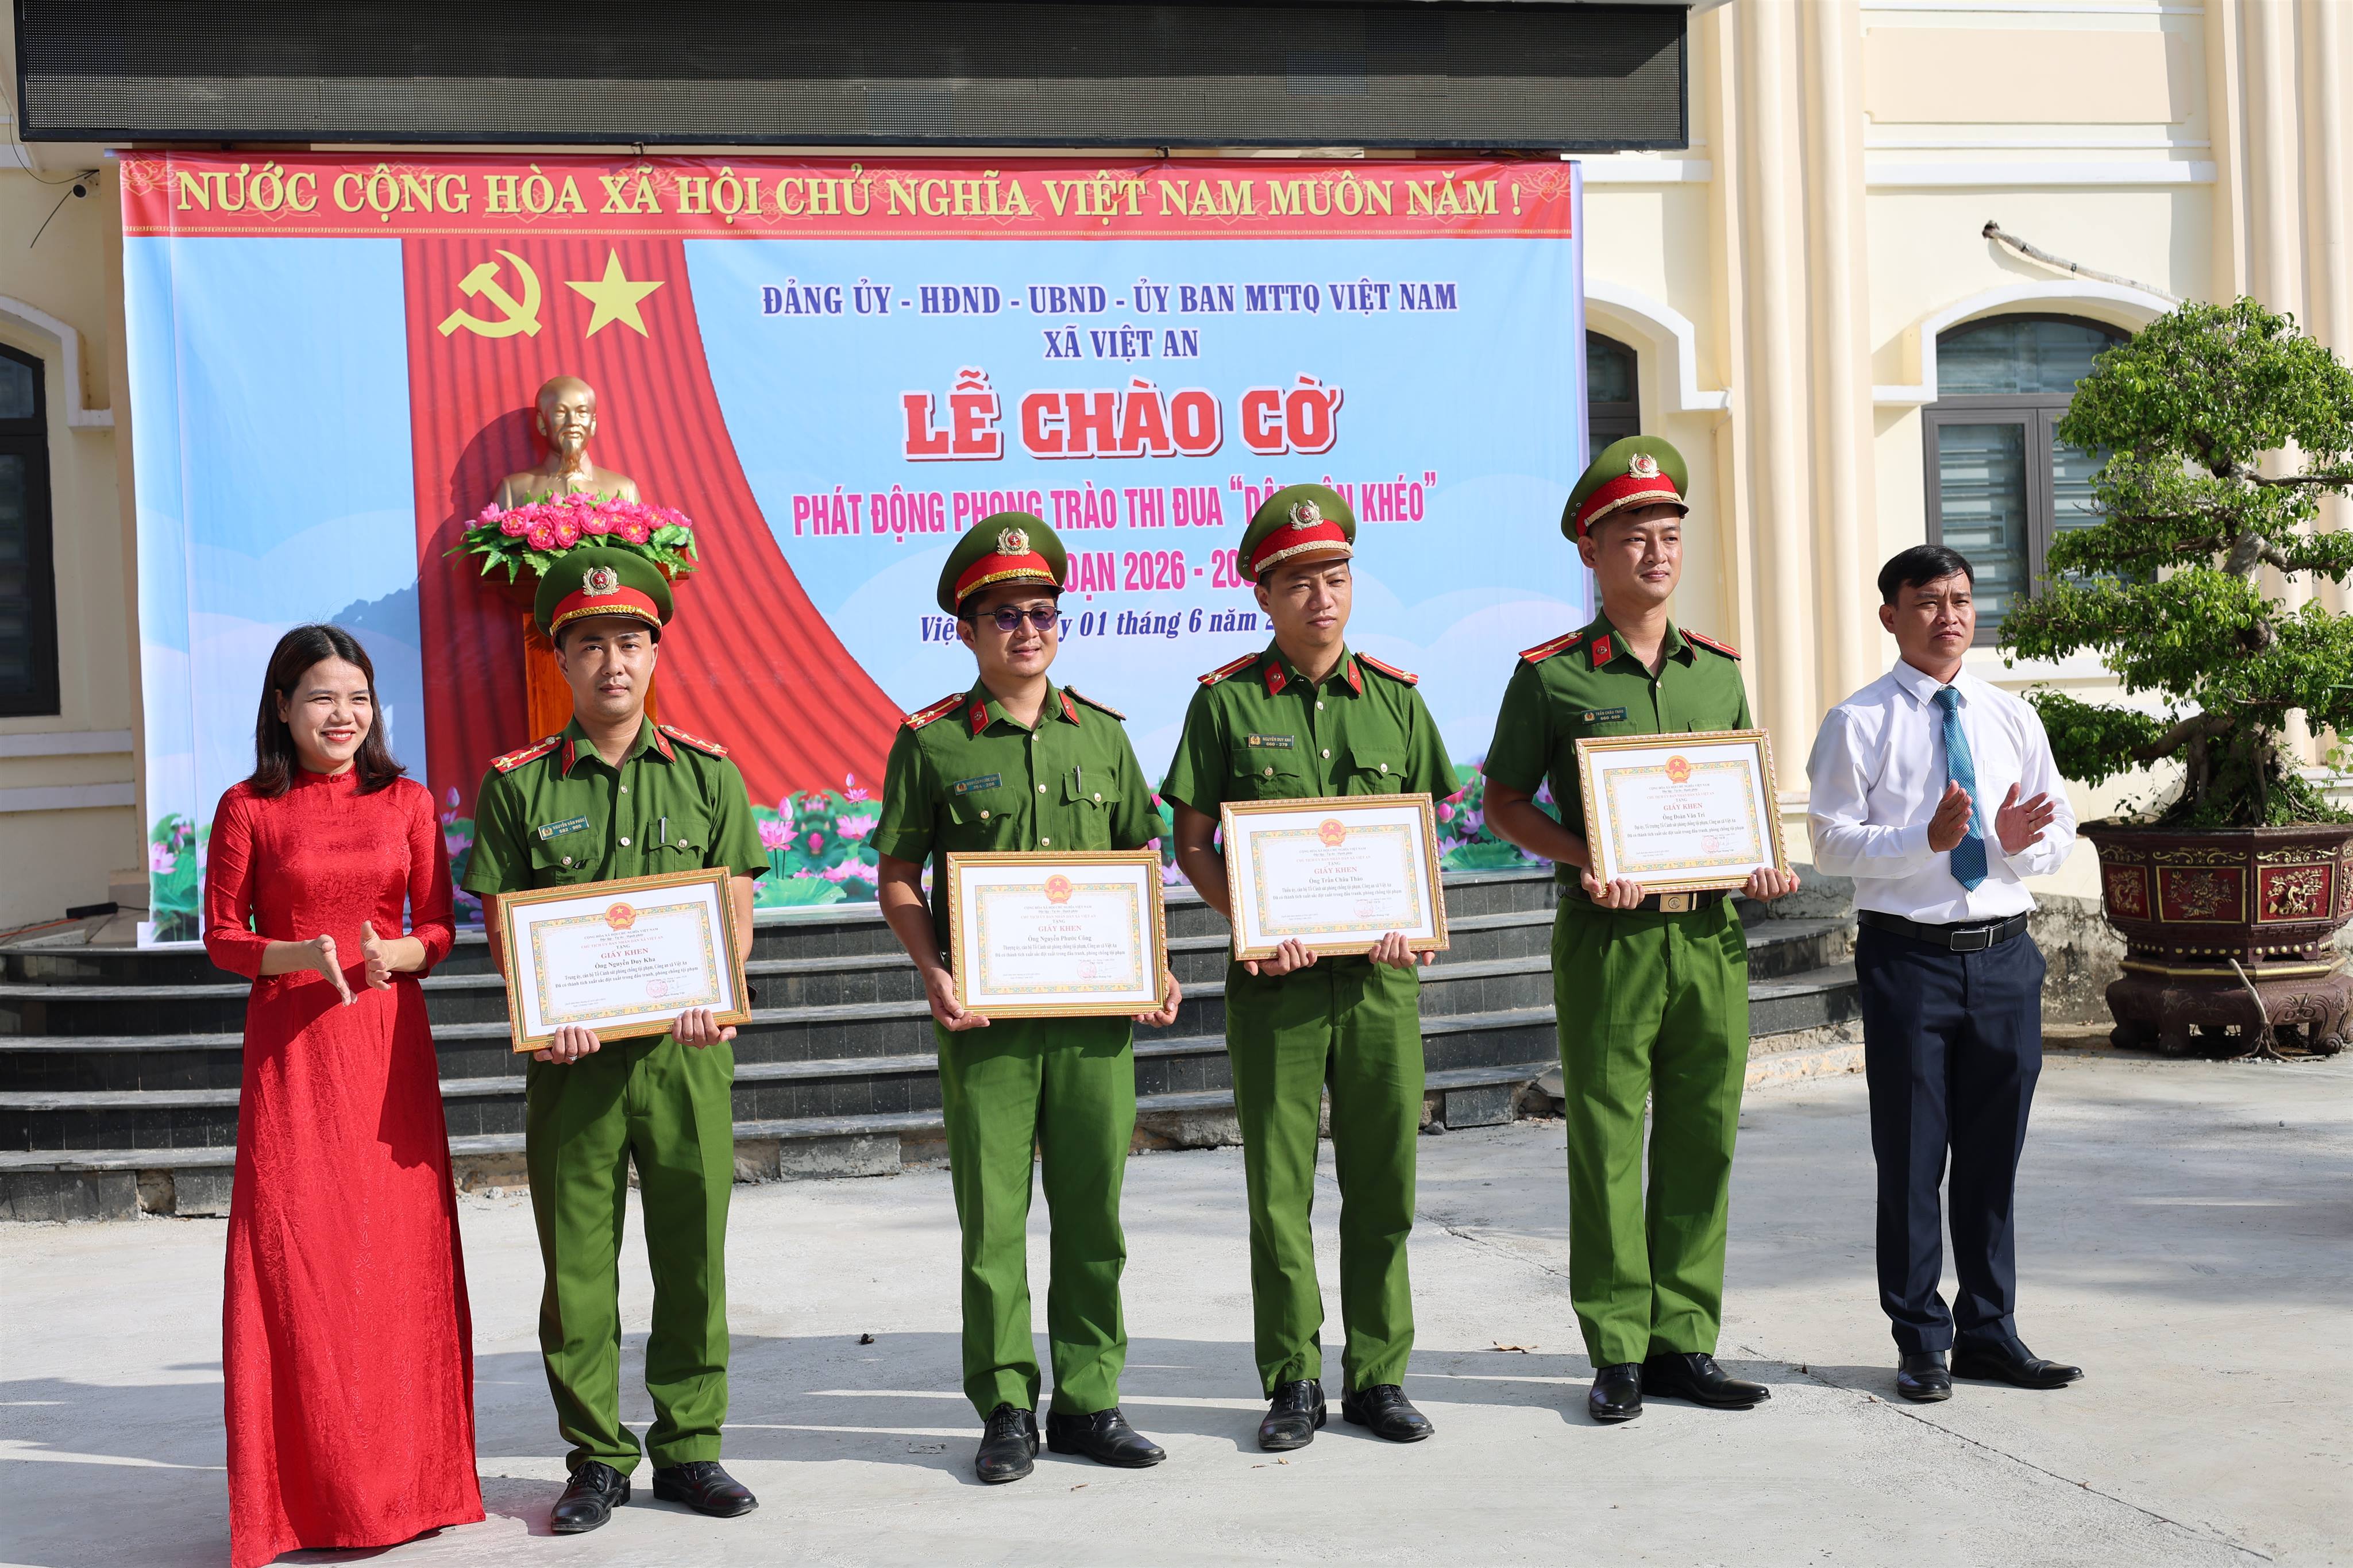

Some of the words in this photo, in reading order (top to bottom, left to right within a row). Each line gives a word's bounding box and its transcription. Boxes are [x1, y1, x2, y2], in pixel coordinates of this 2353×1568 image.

[177, 164, 319, 212] NƯỚC
[333, 164, 470, 221] CỘNG
[485, 164, 587, 214] HÒA
[599, 167, 662, 214] XÃ
[677, 168, 762, 223] HỘI
[776, 163, 871, 215] CHỦ
[886, 171, 1032, 215] NGHĨA
[1044, 171, 1146, 225] VIỆT
[1160, 180, 1255, 215] NAM
[1269, 171, 1392, 215] MUÔN
[1408, 169, 1498, 215] NĂM
[1511, 183, 1522, 215] !
[763, 279, 843, 314] ĐẢNG
[854, 279, 890, 314] ỦY
[920, 286, 1001, 314] HĐND
[1028, 285, 1106, 314] UBND
[1134, 278, 1168, 313] ỦY
[1180, 285, 1234, 312] BAN
[1245, 284, 1320, 314] MTTQ
[1329, 279, 1390, 315] VIỆT
[1400, 284, 1457, 310] NAM
[1044, 325, 1081, 358] XÃ
[1090, 325, 1153, 362] VIỆT
[1163, 330, 1198, 357] AN
[902, 369, 997, 455] LỄ
[1021, 379, 1218, 454] CHÀO
[1241, 375, 1337, 450] CỜ
[793, 485, 862, 536] PHÁT
[870, 484, 946, 543] ĐỘNG
[1050, 481, 1117, 530] TRÀO
[1124, 488, 1166, 528] THI
[1172, 486, 1224, 527] ĐUA
[1124, 550, 1186, 591] 2026
[921, 616, 962, 646] Việ
[1079, 611, 1107, 636] 01
[1117, 609, 1181, 638] tháng
[1189, 608, 1203, 633] 6
[1209, 608, 1257, 632] năm
[1314, 866, 1333, 874] GIẤY
[601, 949, 622, 959] GIẤY
[608, 959, 629, 968] Nguyễn
